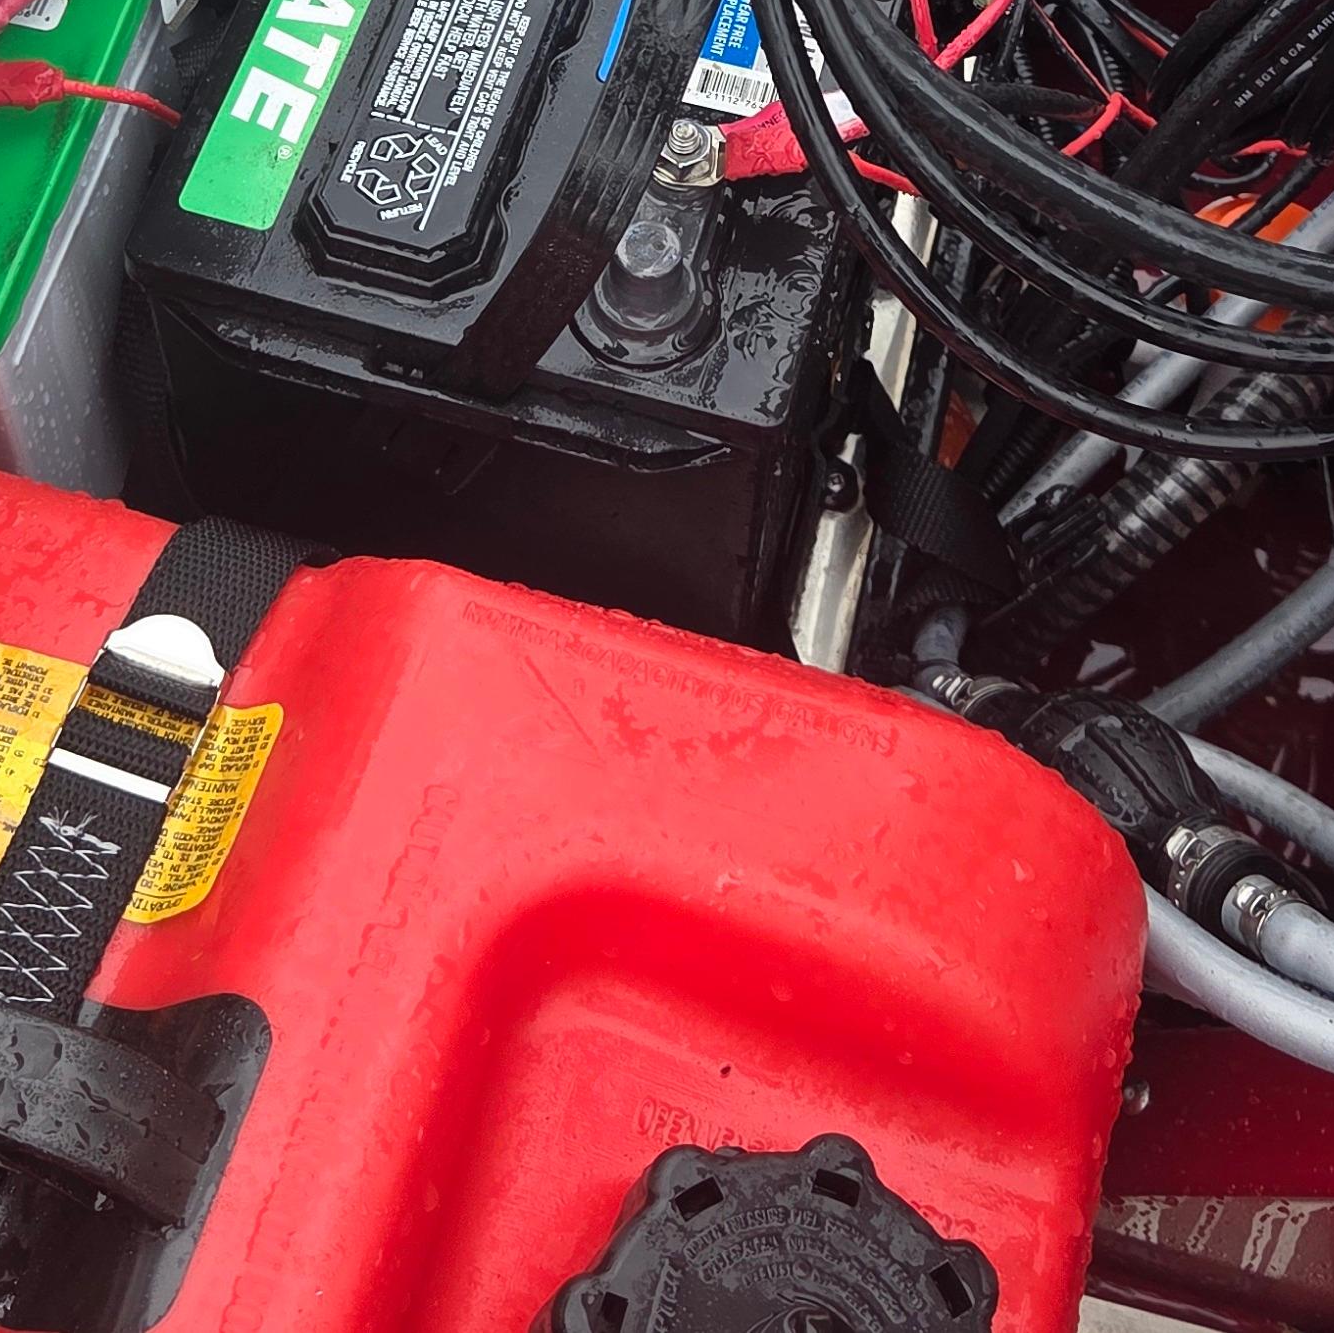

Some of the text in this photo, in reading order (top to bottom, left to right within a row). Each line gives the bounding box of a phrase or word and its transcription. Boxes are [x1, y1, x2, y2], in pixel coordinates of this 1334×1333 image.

[428, 1, 439, 10] IN
[435, 1, 451, 21] SAFE
[408, 8, 424, 28] SEEK
[414, 11, 435, 42] VEHICLE
[508, 10, 522, 28] NOT
[427, 21, 442, 42] JUMP
[444, 26, 464, 52] HELP
[475, 22, 495, 48] EYES
[395, 28, 416, 59] SERVICE
[410, 43, 433, 80] STARTING
[432, 54, 453, 79] FAST
[451, 51, 469, 72] GET
[493, 46, 508, 68] KEEP
[449, 50, 485, 114] IMMEDIATELY
[484, 69, 499, 90] VENT
[397, 80, 418, 113] FOLLOW
[462, 15, 531, 172] KEEP OUT OF THE REACH OF CHILDREN
[473, 91, 490, 113] CAPS
[463, 116, 481, 141] TIGHT
[424, 134, 448, 155] LEAD
[455, 140, 470, 159] AND
[340, 141, 366, 183] RECYCLE
[380, 203, 423, 219] RETURN
